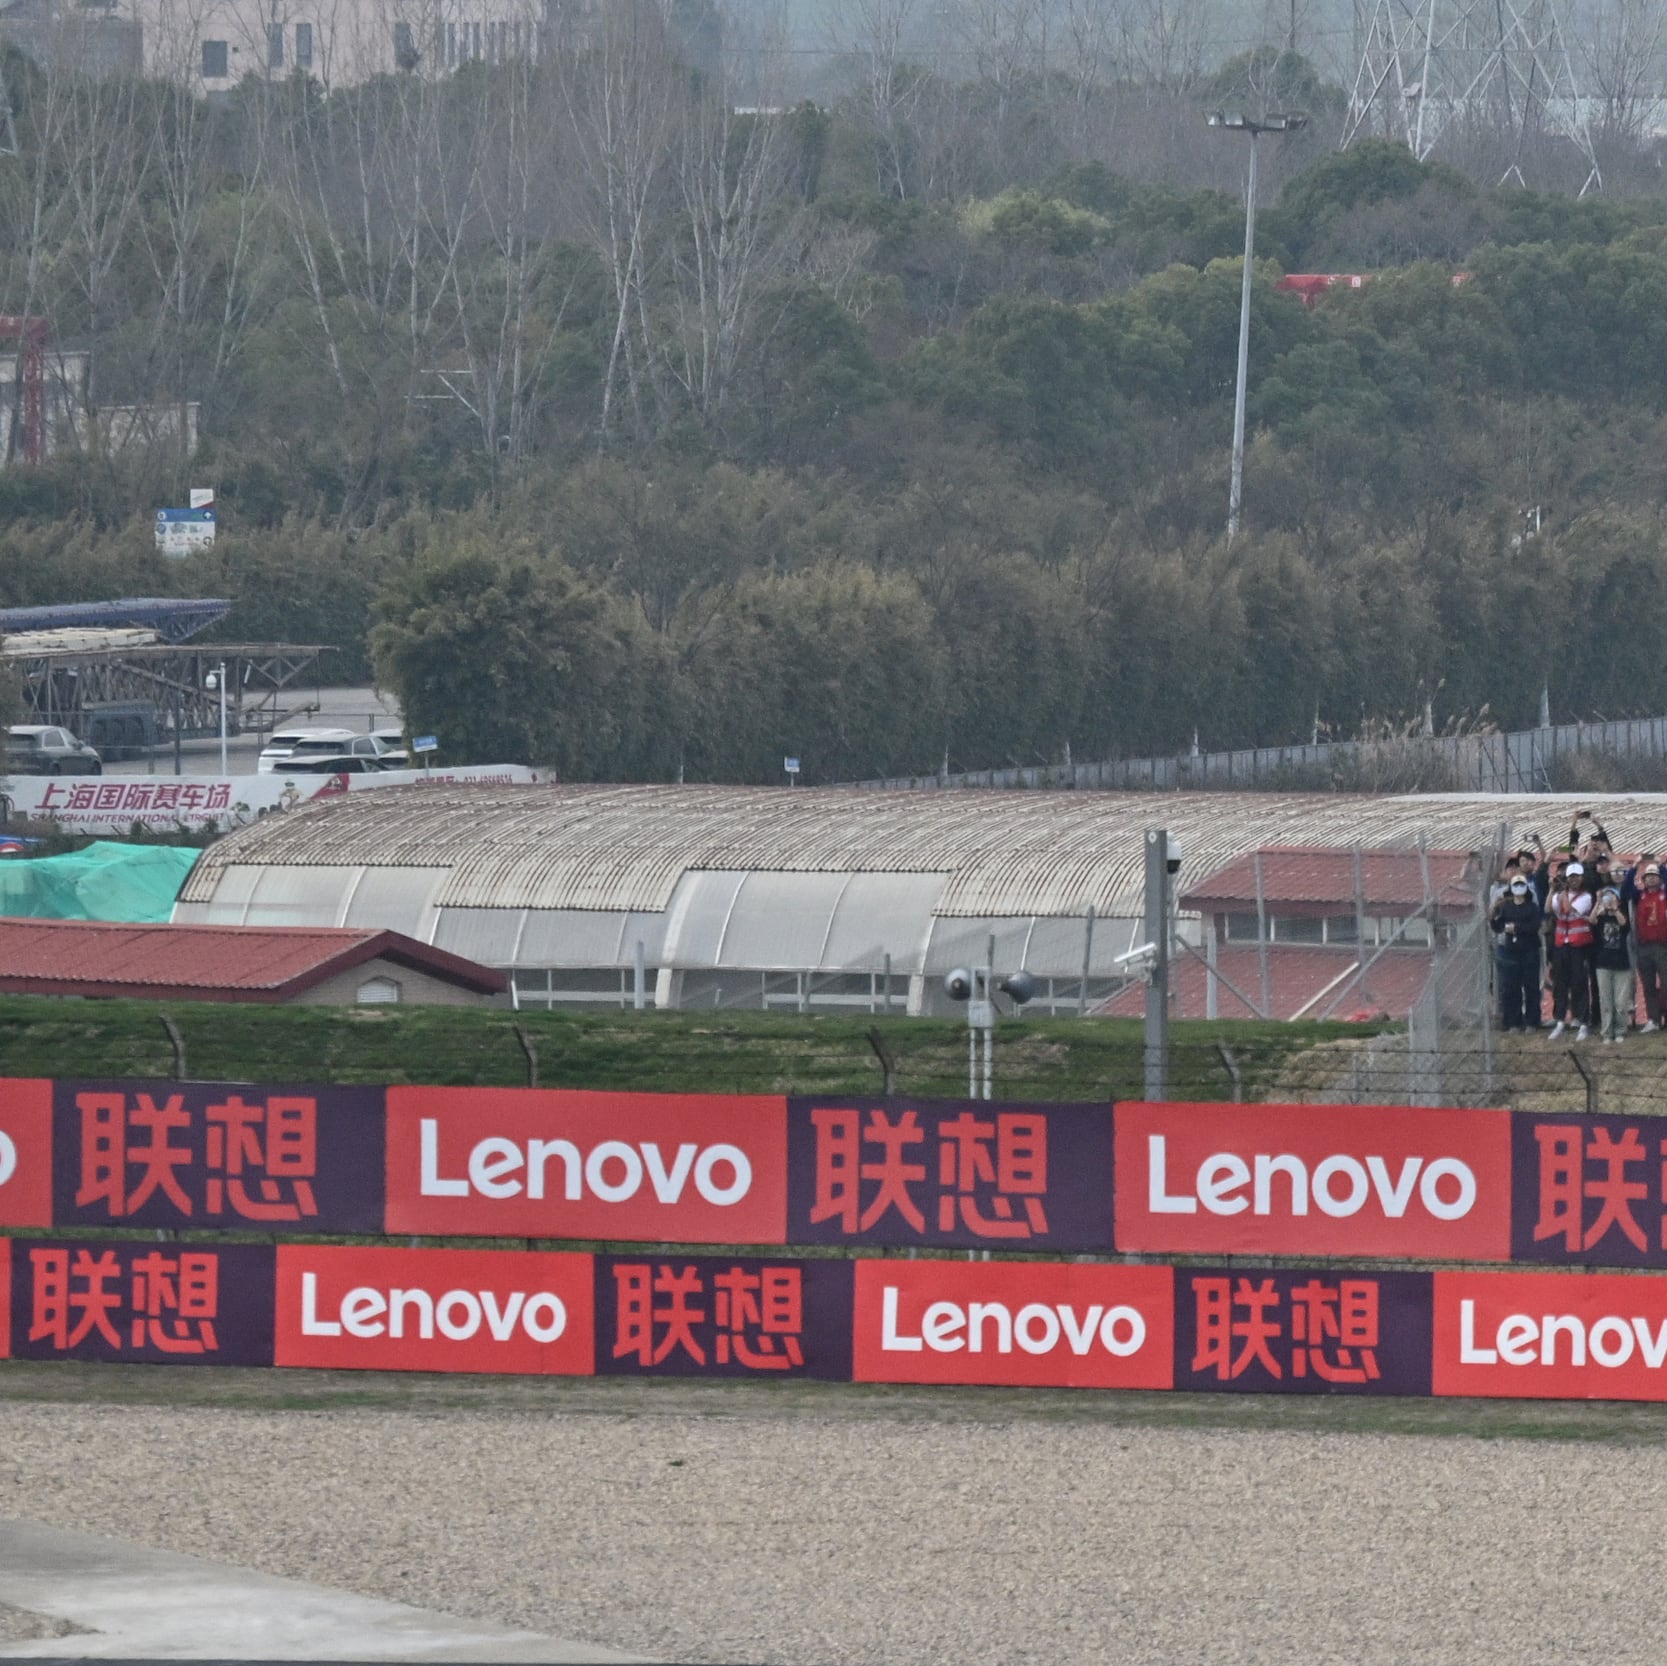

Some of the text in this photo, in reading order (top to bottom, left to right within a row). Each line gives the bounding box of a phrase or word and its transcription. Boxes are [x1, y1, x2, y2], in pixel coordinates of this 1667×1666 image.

[34, 783, 232, 811] 上海国际赛车场
[76, 1093, 317, 1220] 联想
[420, 1118, 752, 1206] Lenovo
[810, 1109, 1048, 1238] 联想
[1149, 1134, 1477, 1220] Lenovo
[29, 1248, 218, 1353] 联想
[302, 1272, 567, 1343] Lenovo
[613, 1264, 803, 1369] 联想
[882, 1286, 1146, 1356] Lenovo
[1192, 1277, 1380, 1383] 联想
